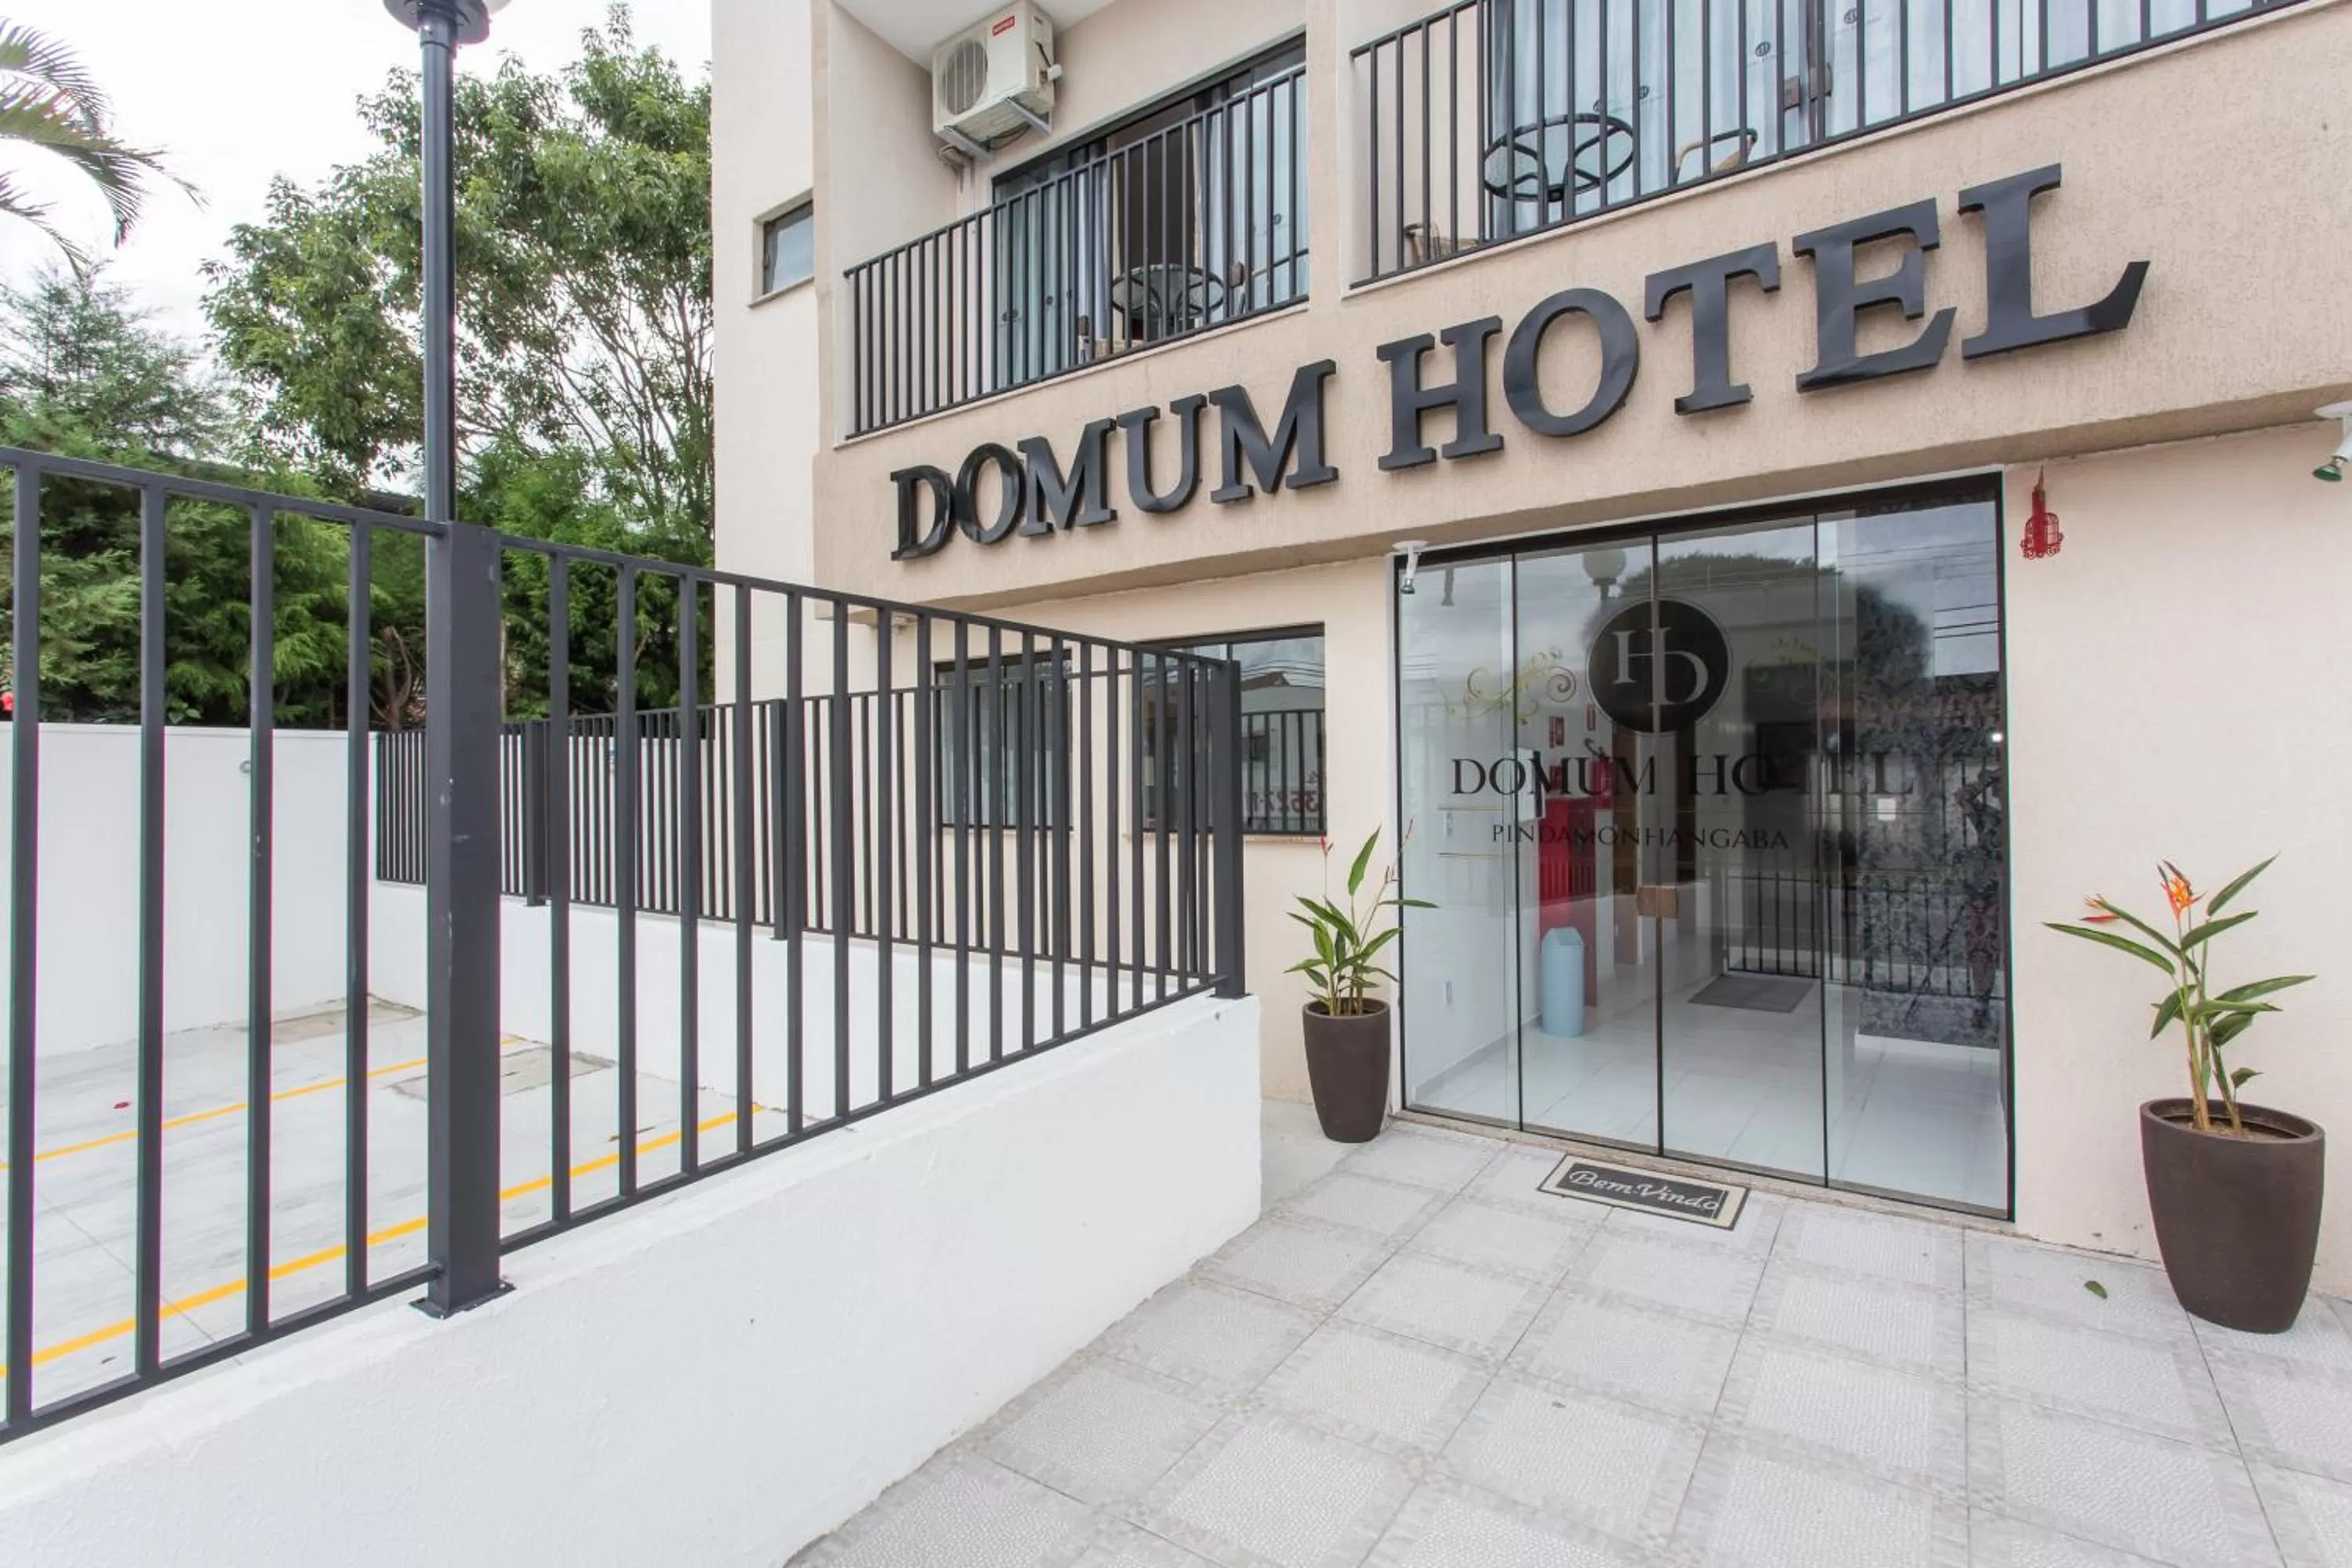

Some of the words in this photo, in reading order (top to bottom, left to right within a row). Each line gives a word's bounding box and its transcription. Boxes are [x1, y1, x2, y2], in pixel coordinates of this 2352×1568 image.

[891, 358, 1339, 561] DOMUM
[1377, 162, 2150, 470] HOTEL
[1452, 754, 1657, 797] DOMUM
[1492, 823, 1789, 851] PINDAMONHANGABA
